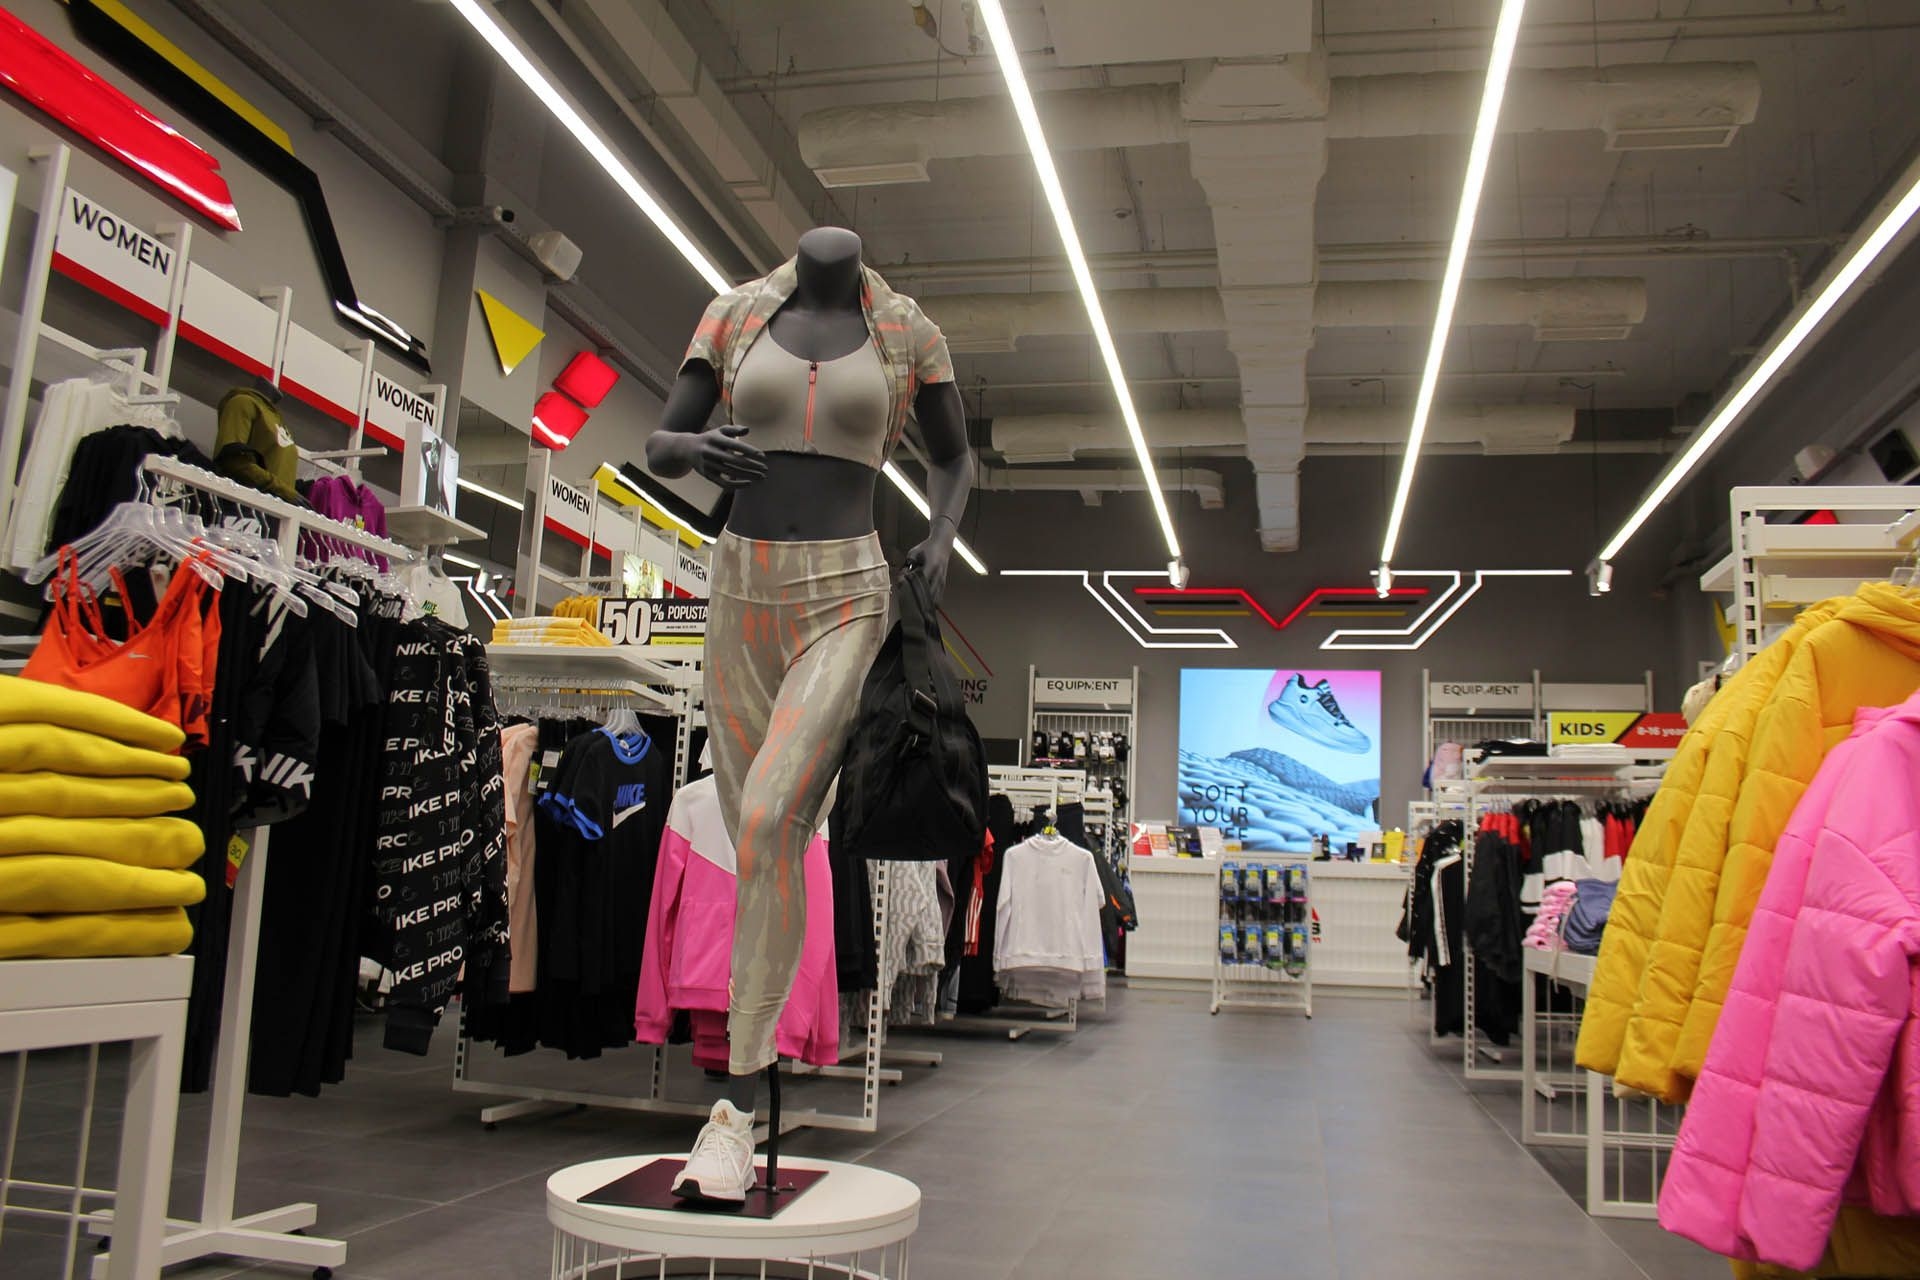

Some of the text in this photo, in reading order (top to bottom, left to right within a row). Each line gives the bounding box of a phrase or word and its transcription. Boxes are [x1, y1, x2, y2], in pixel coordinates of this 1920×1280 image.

[72, 196, 171, 276] WOMEN
[377, 377, 435, 427] WOMEN
[551, 479, 591, 516] WOMEN
[679, 555, 708, 583] WOMEN
[602, 600, 652, 646] 50
[1047, 680, 1120, 691] EQUIPMENT
[1443, 684, 1521, 696] EQUIPMENT
[1560, 722, 1606, 736] KIDS
[616, 783, 646, 809] NIKE
[1191, 784, 1249, 802] SOFT
[1190, 806, 1249, 824] YOUR
